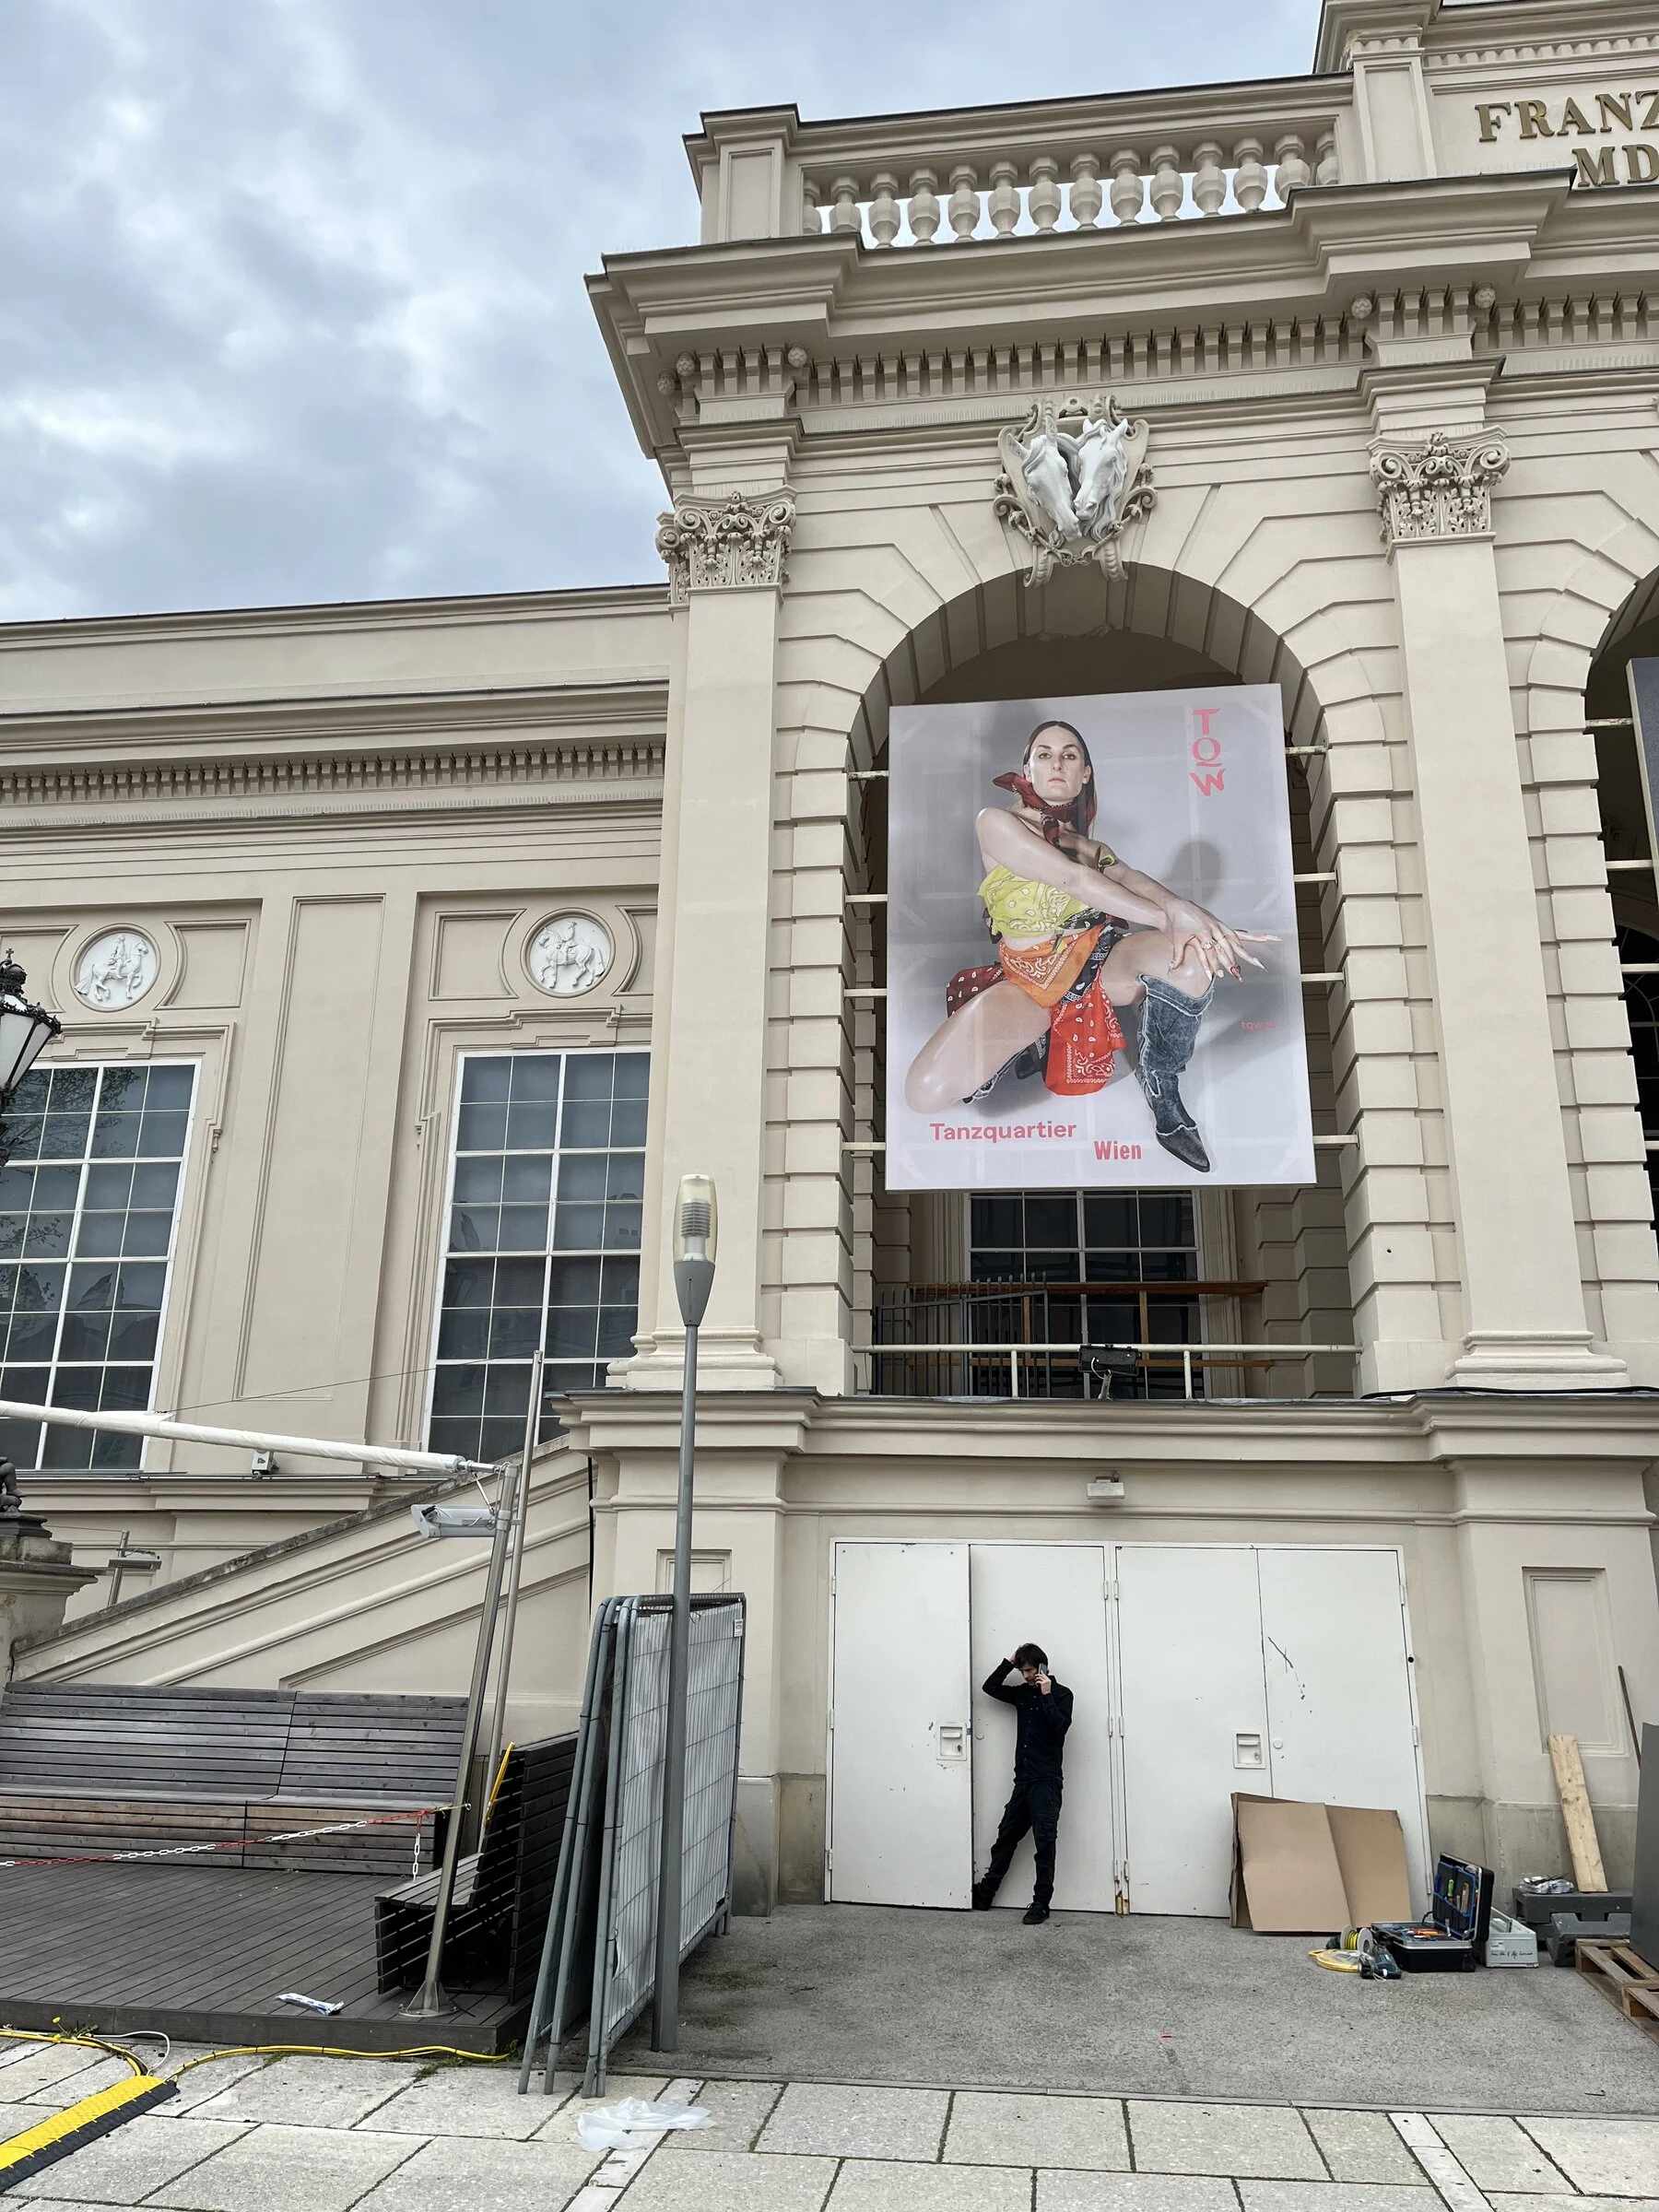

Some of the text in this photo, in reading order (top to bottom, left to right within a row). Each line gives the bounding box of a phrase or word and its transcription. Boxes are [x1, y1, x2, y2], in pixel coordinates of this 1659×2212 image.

[1475, 89, 1659, 142] FRANZ
[1190, 708, 1225, 796] TQW
[929, 1121, 1077, 1143] Tanzquartier
[1094, 1140, 1142, 1160] Wien
